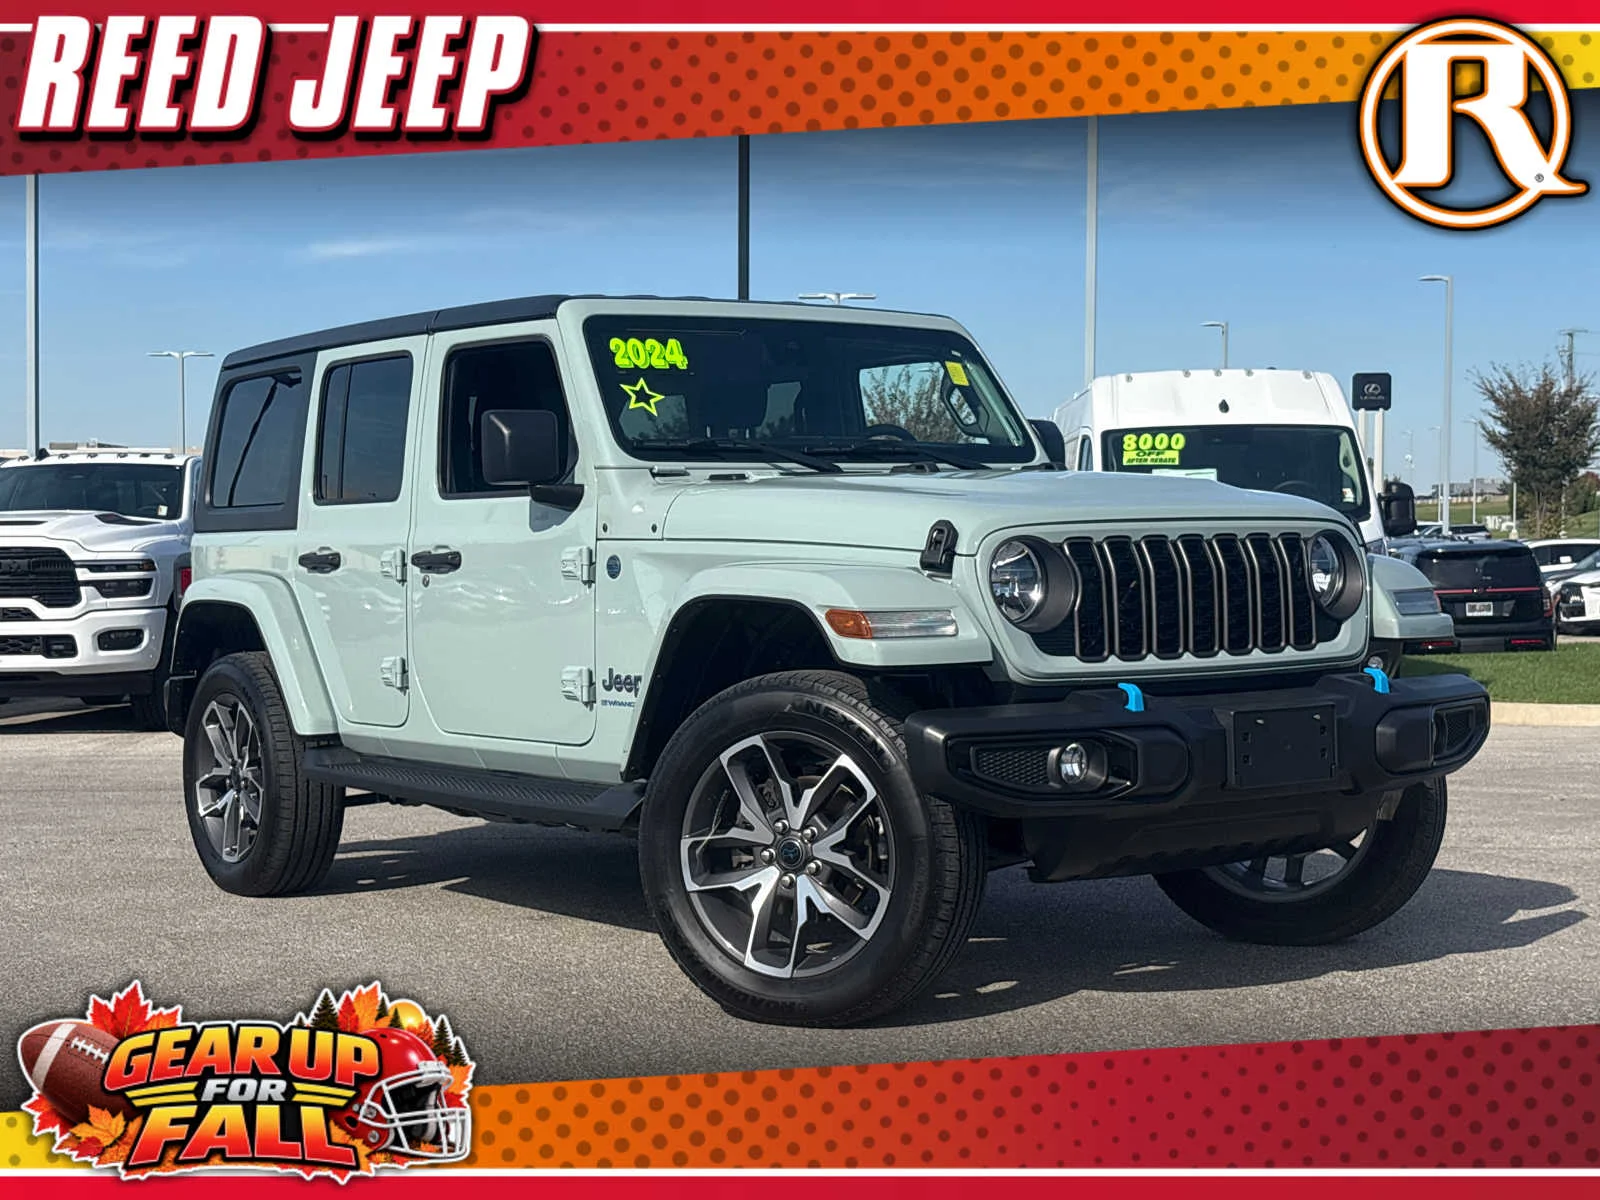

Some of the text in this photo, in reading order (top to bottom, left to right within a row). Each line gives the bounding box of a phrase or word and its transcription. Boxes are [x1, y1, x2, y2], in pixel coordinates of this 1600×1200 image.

[609, 337, 689, 370] 2024
[1123, 433, 1186, 451] 8000
[1135, 450, 1166, 458] OFF
